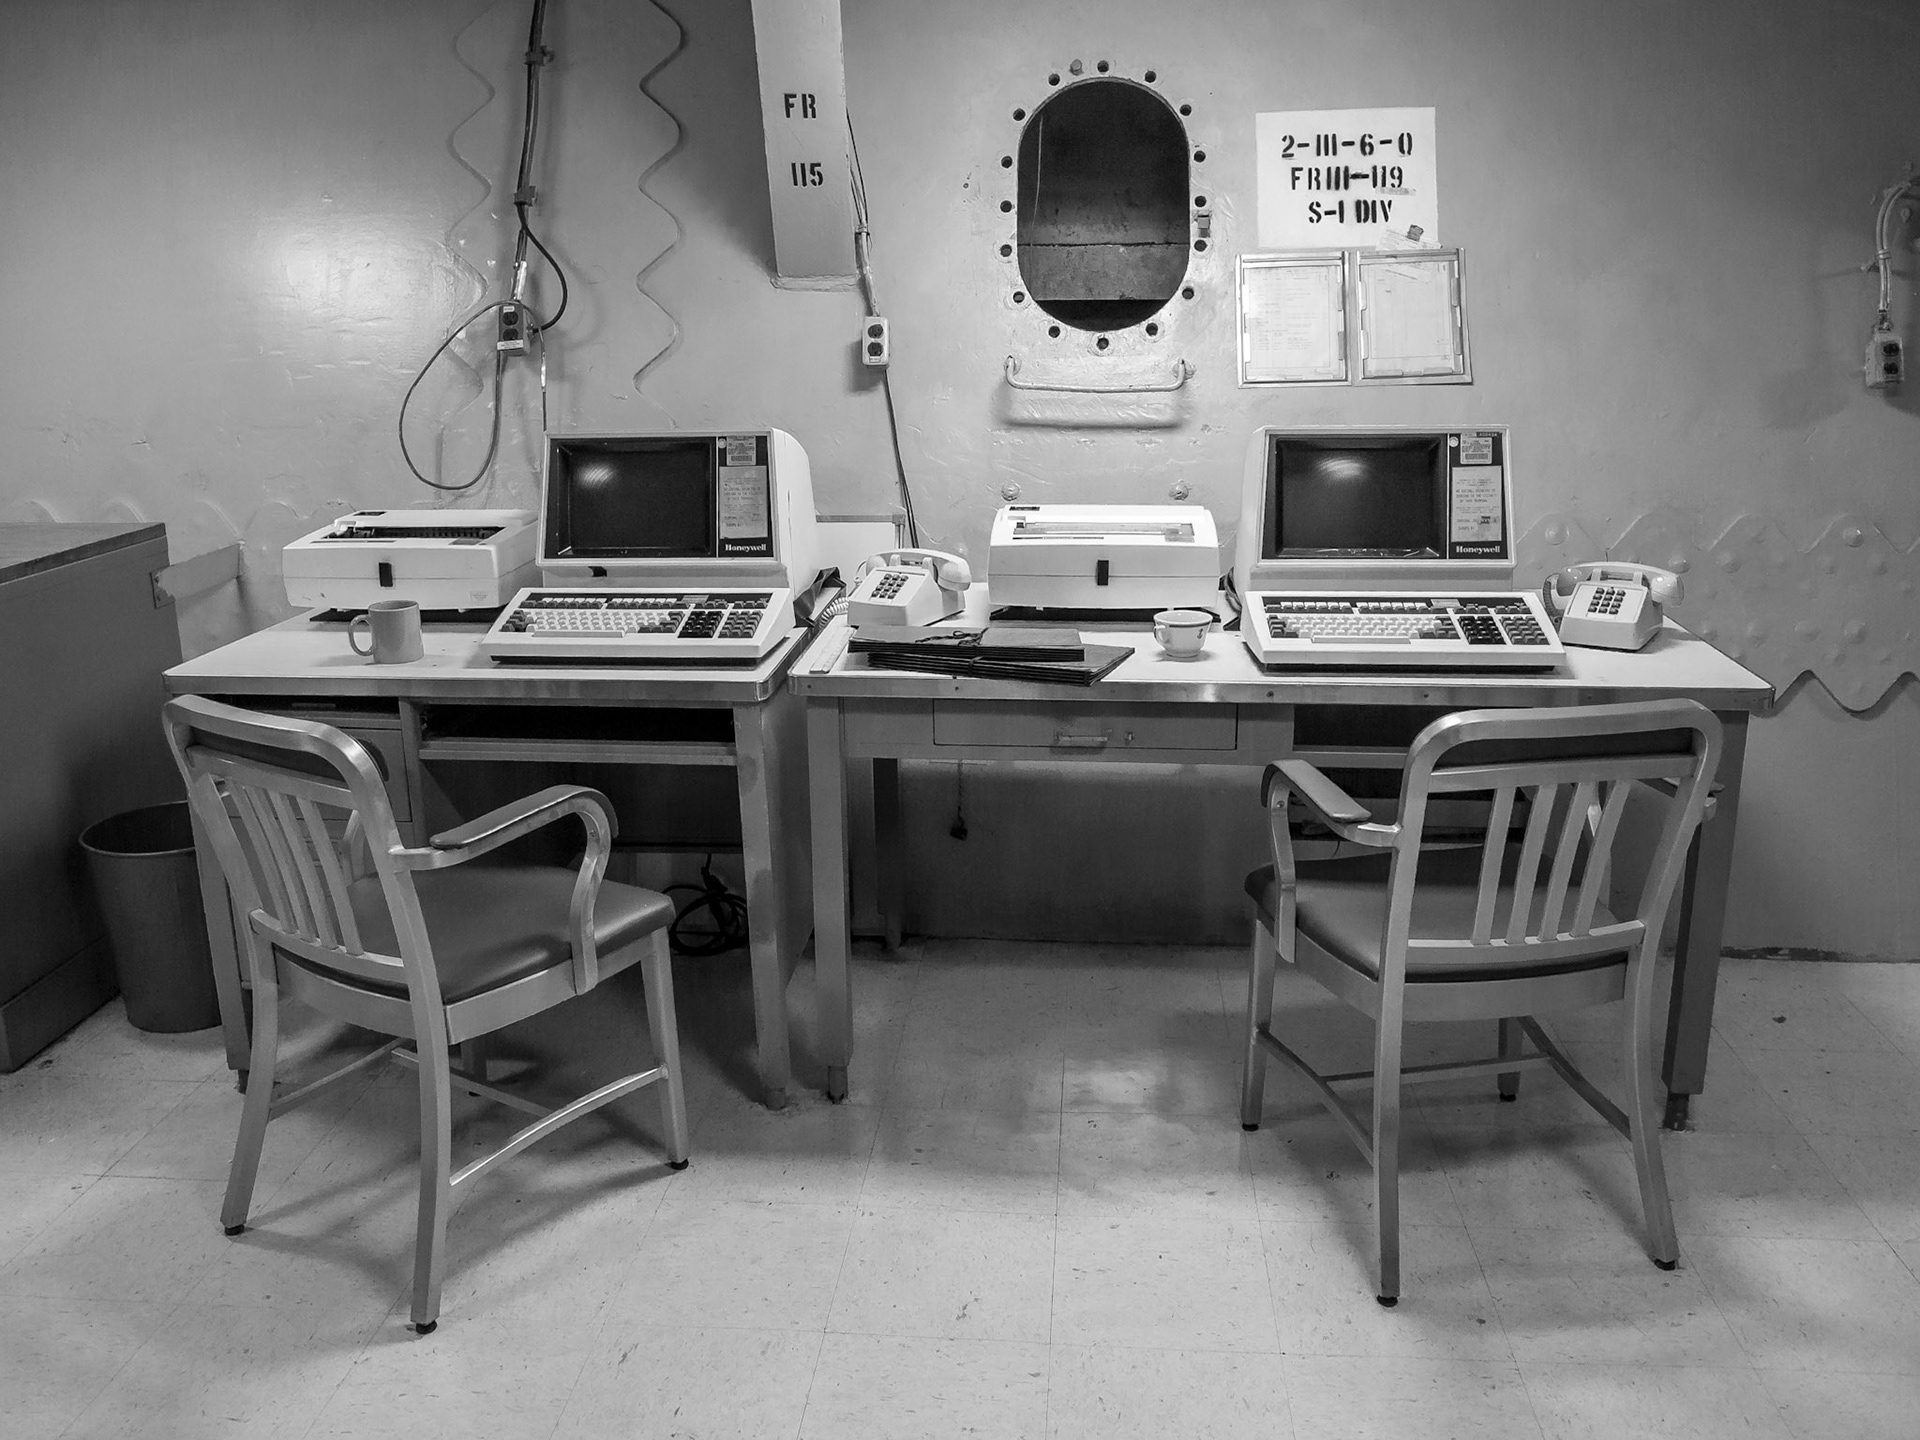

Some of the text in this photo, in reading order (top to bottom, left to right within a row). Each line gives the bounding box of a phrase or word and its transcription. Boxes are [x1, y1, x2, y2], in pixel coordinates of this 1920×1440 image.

[783, 93, 817, 119] FR
[791, 162, 824, 188] 115
[1354, 199, 1393, 224] DIV
[725, 544, 767, 552] Honeywell
[1456, 545, 1500, 554] Honeywell
